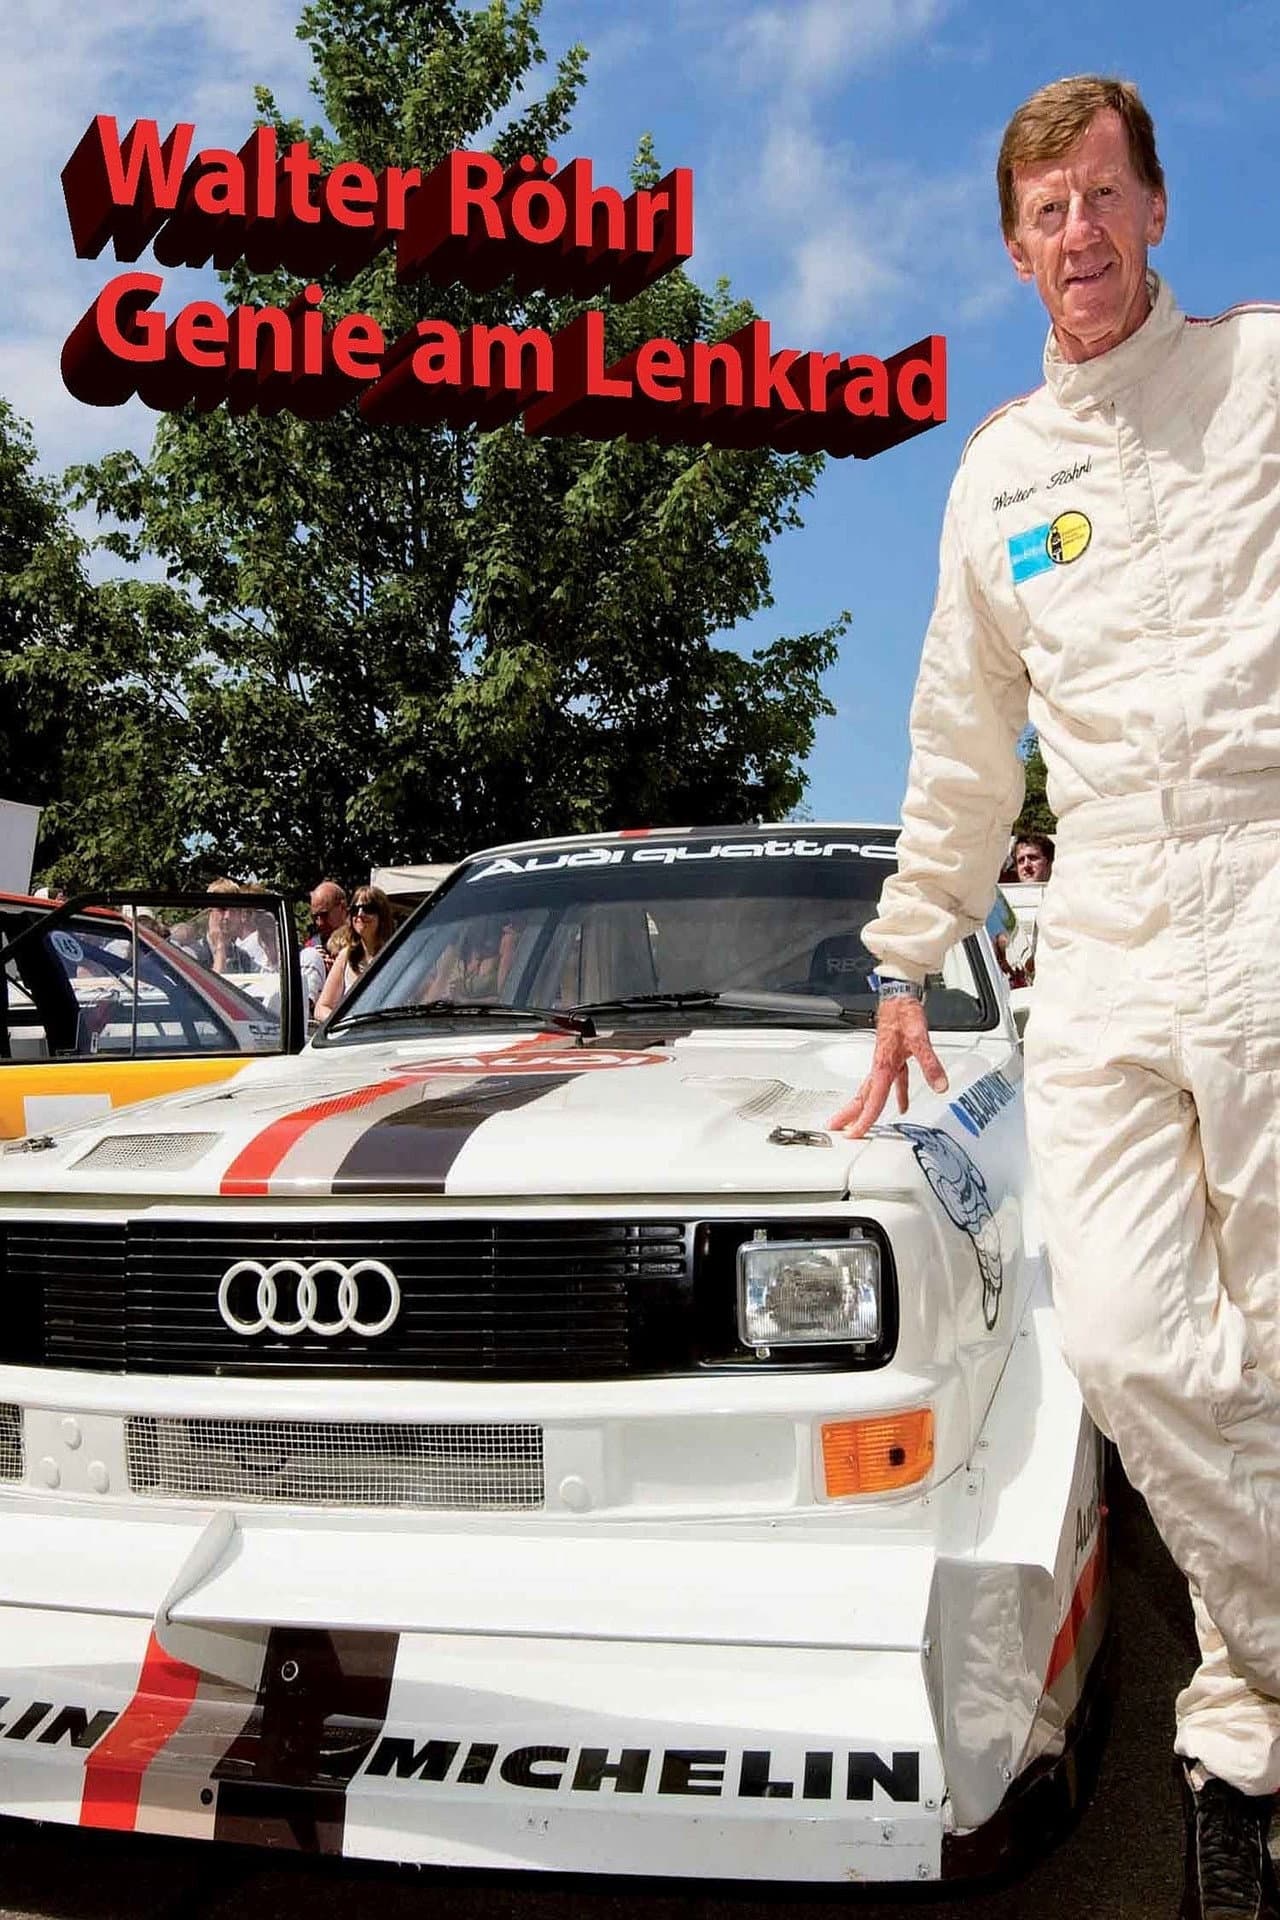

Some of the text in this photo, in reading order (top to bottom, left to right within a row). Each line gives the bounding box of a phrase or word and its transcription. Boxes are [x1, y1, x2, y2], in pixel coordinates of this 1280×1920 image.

[992, 486, 1037, 511] Walter
[958, 1070, 1017, 1131] BLAUPUNKT
[0, 1696, 120, 1748] IN
[364, 1737, 919, 1802] MICHELIN
